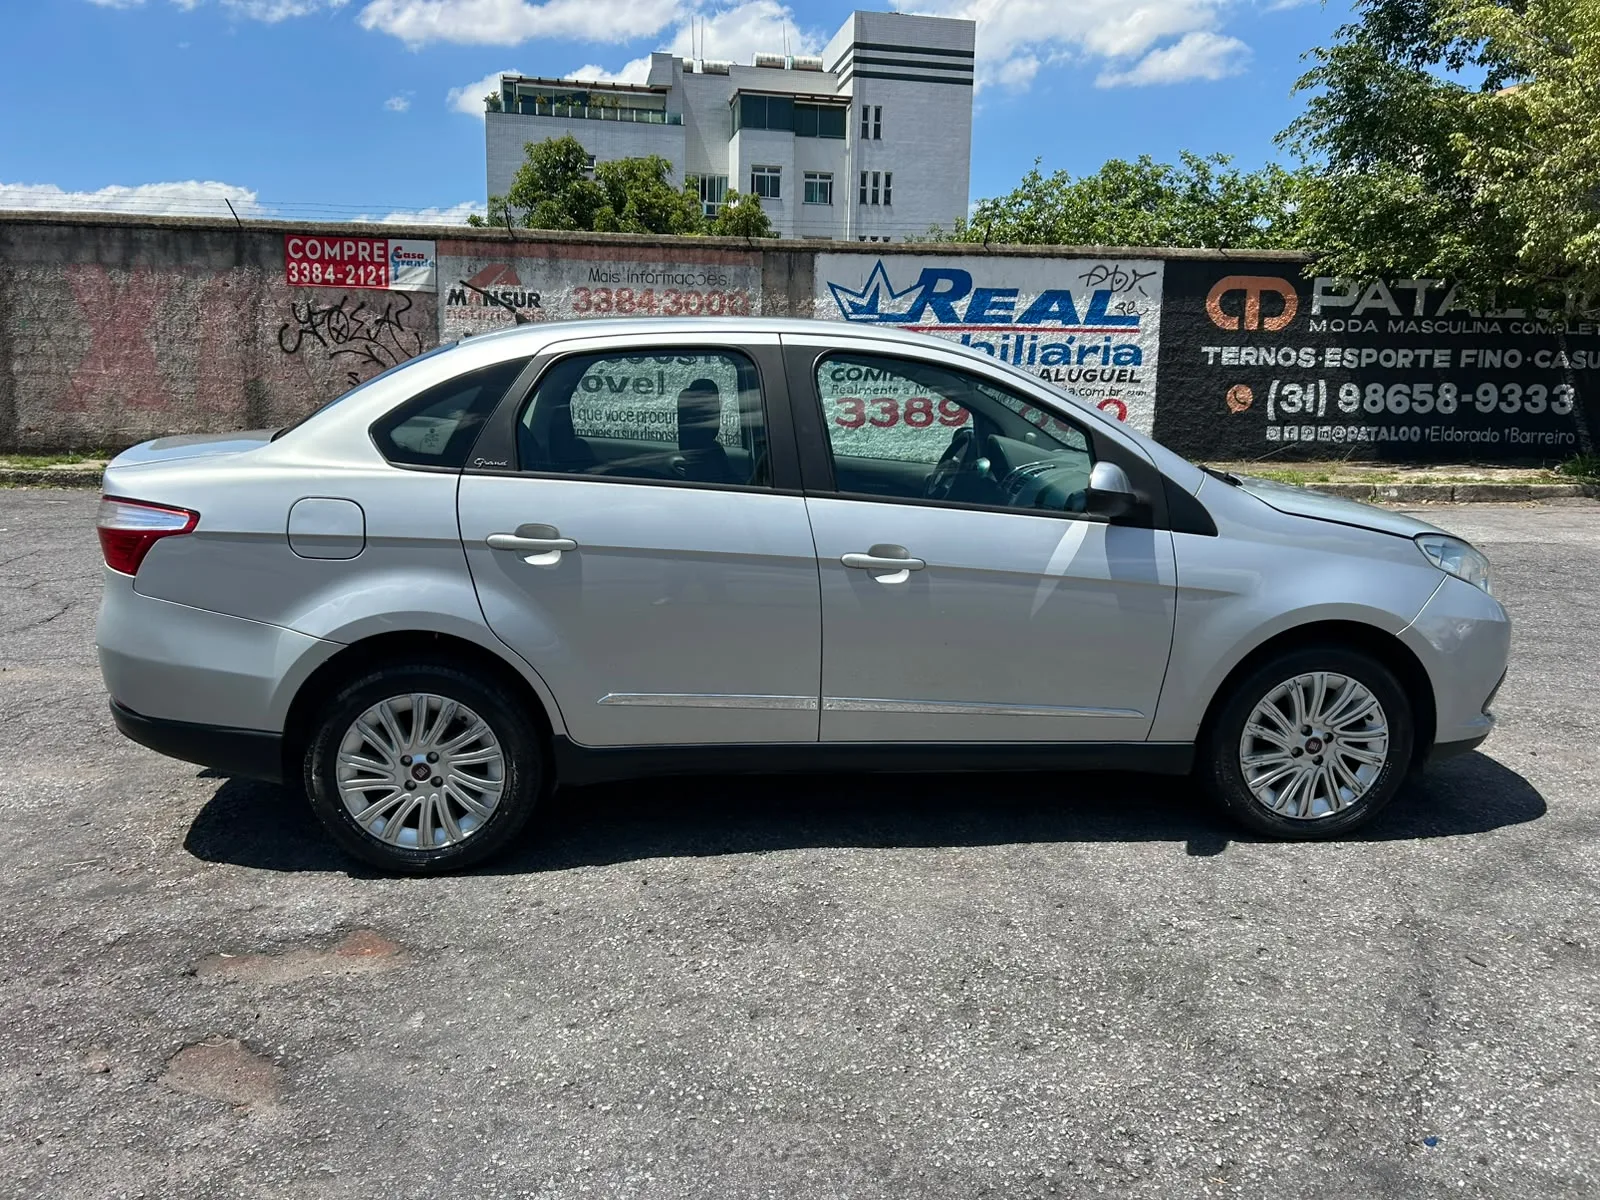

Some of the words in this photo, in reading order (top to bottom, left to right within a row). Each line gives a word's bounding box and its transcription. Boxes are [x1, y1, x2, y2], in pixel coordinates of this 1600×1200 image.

[287, 238, 386, 263] COMPRE
[393, 245, 425, 259] Casa
[287, 261, 387, 286] 3384-2121
[588, 267, 621, 283] Mais
[446, 288, 541, 308] MANSUR
[908, 268, 1140, 326] REAL
[1309, 319, 1378, 333] MODA
[1388, 319, 1503, 334] MASCULINA
[961, 334, 1143, 366] biliária
[1460, 348, 1522, 369] FINO
[581, 369, 664, 395] óvel
[1039, 368, 1142, 384] ALUGUEL
[831, 384, 898, 395] Realmente
[1266, 379, 1327, 421] (31)
[1337, 382, 1576, 415] 98658-9333
[578, 407, 602, 423] que
[637, 409, 679, 426] procur
[1430, 425, 1500, 443] Eldorado
[1509, 426, 1576, 445] Barreiro
